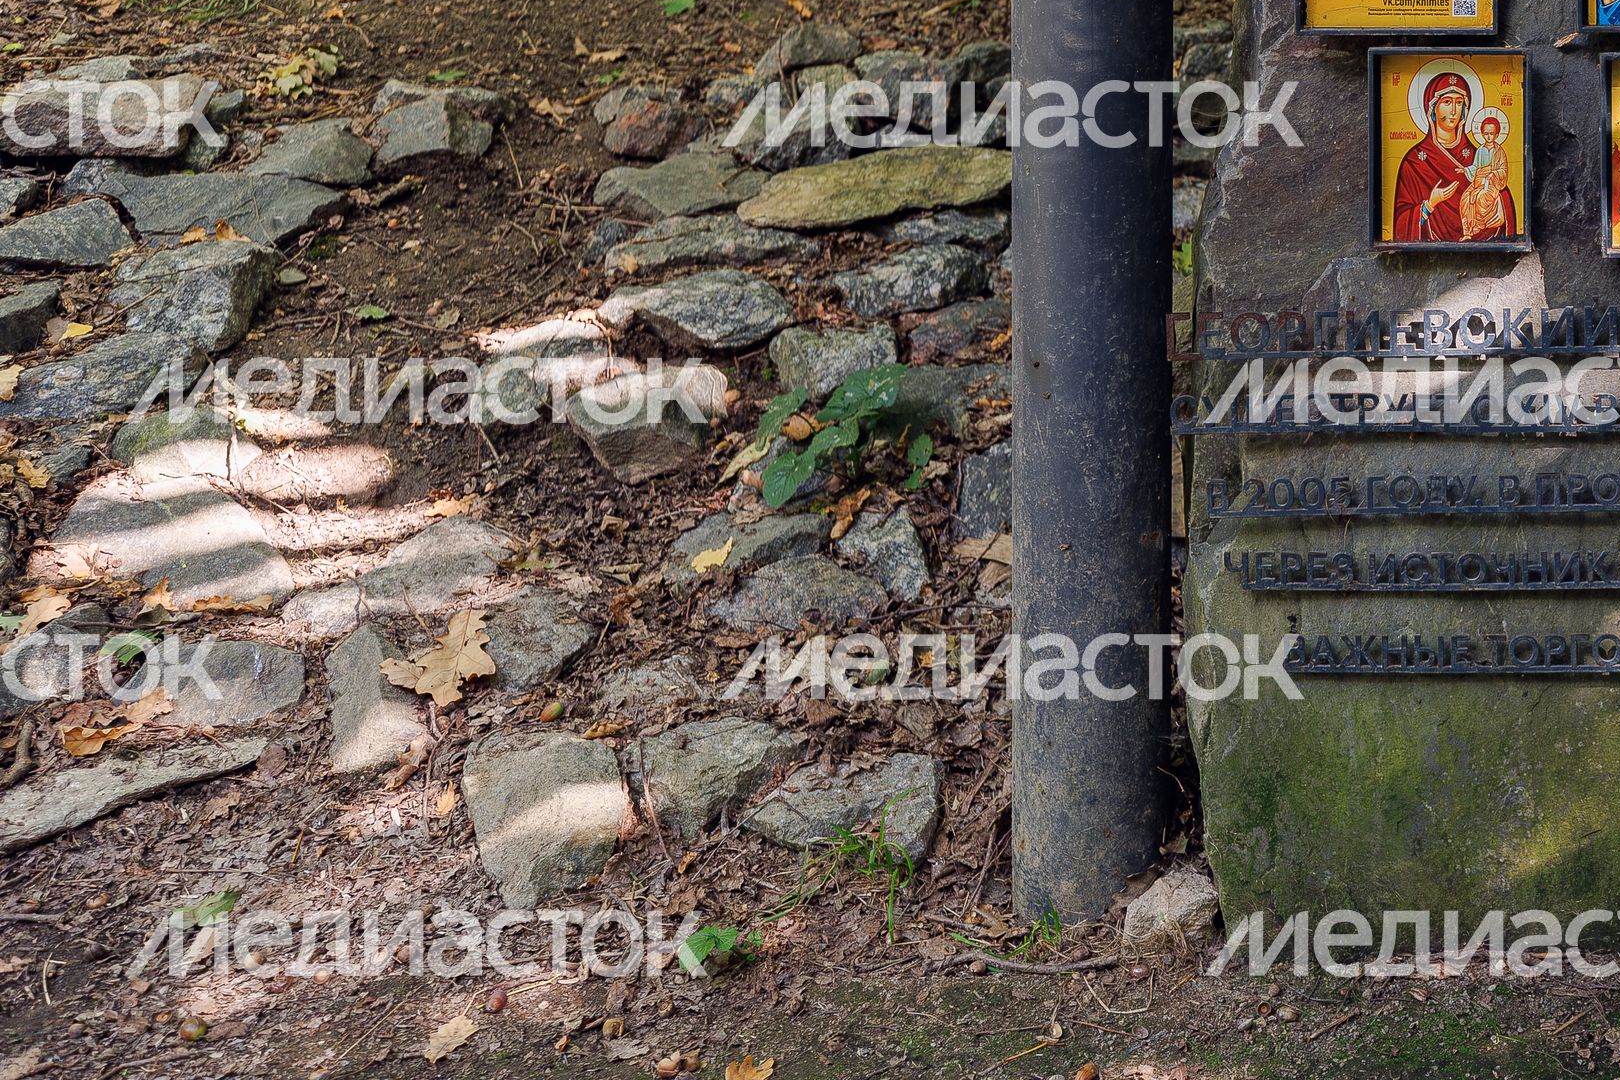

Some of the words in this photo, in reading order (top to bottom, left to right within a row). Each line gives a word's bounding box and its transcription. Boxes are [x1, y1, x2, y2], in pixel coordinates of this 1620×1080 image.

[1207, 478, 1230, 512] В
[1242, 476, 1351, 510] 2005
[1499, 475, 1521, 507] В
[1223, 551, 1355, 589] ЧЕРЕЗ
[1368, 549, 1612, 588] ИСТОЧНИК
[1283, 634, 1472, 671] ВАЖНЫЕ
